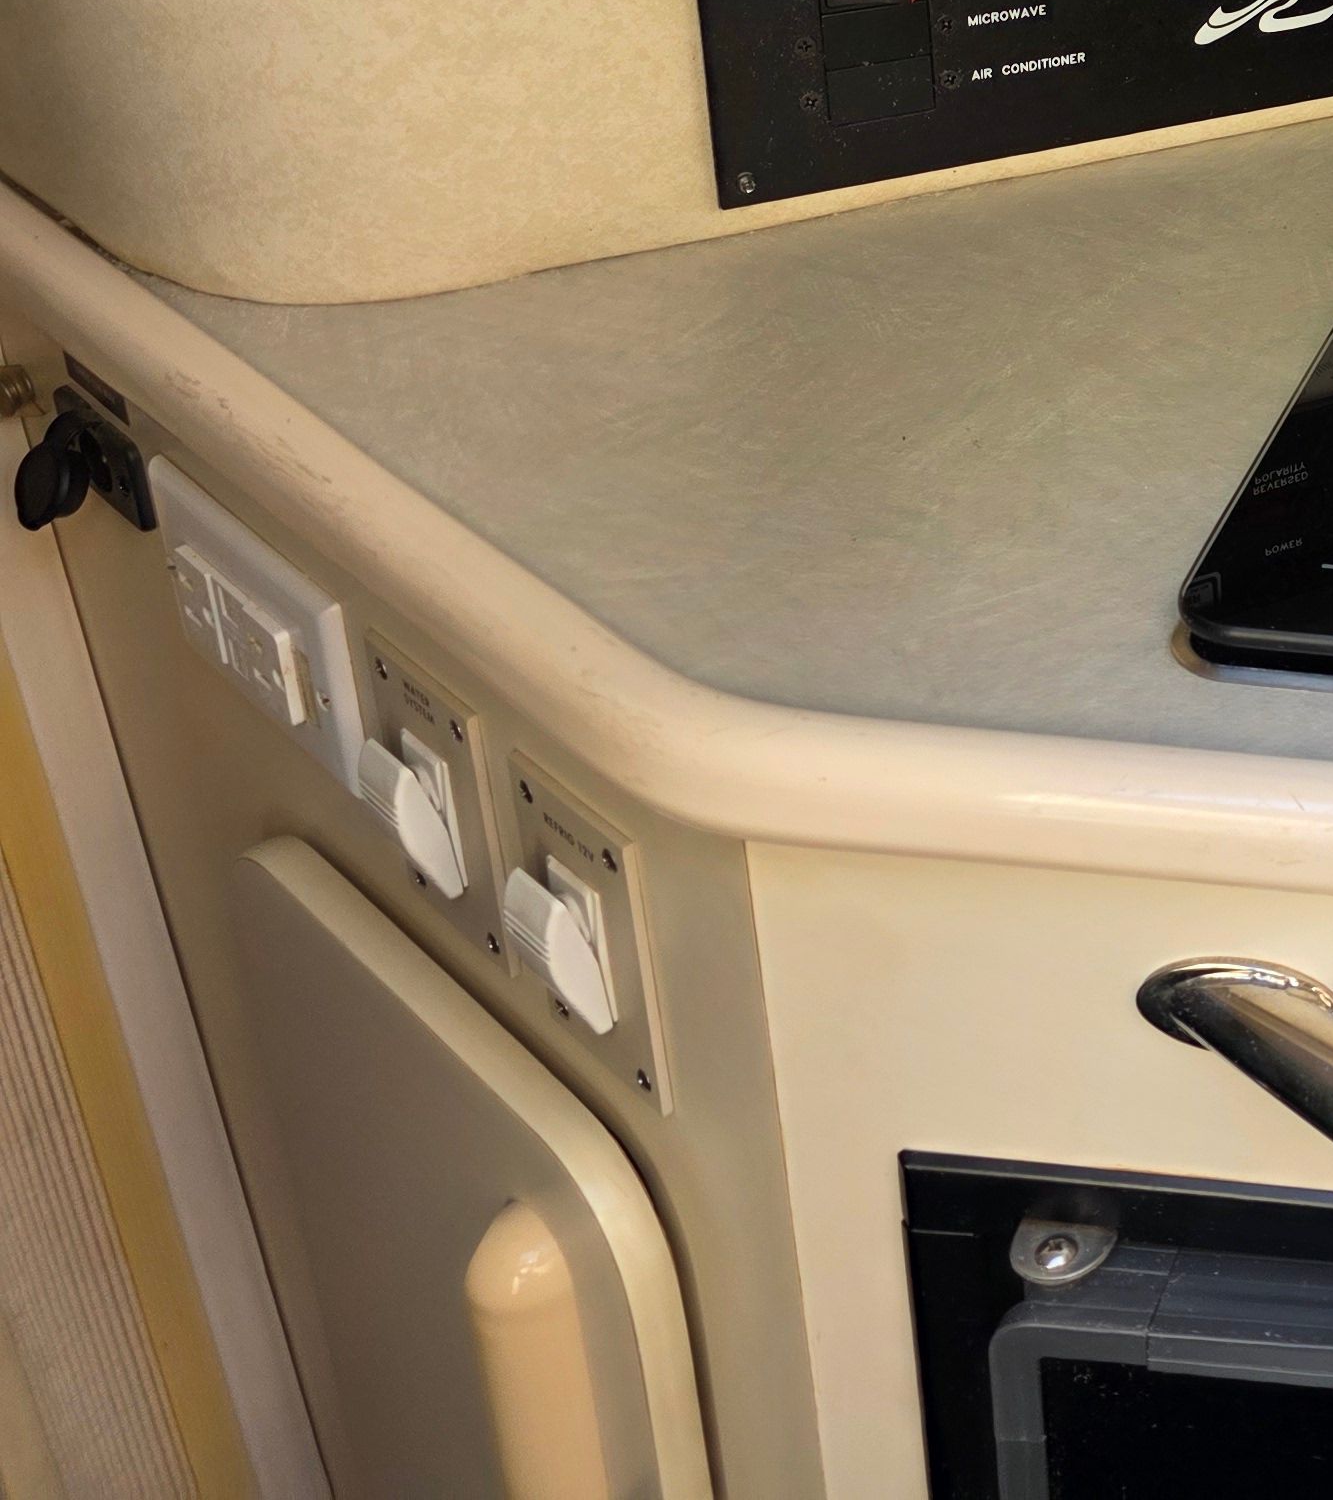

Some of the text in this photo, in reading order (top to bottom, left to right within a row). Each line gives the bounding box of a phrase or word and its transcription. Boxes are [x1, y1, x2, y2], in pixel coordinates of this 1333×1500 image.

[967, 4, 1047, 27] MICROWAVE
[971, 52, 1086, 82] AIR CONDITIONER
[543, 811, 575, 846] REFRIG
